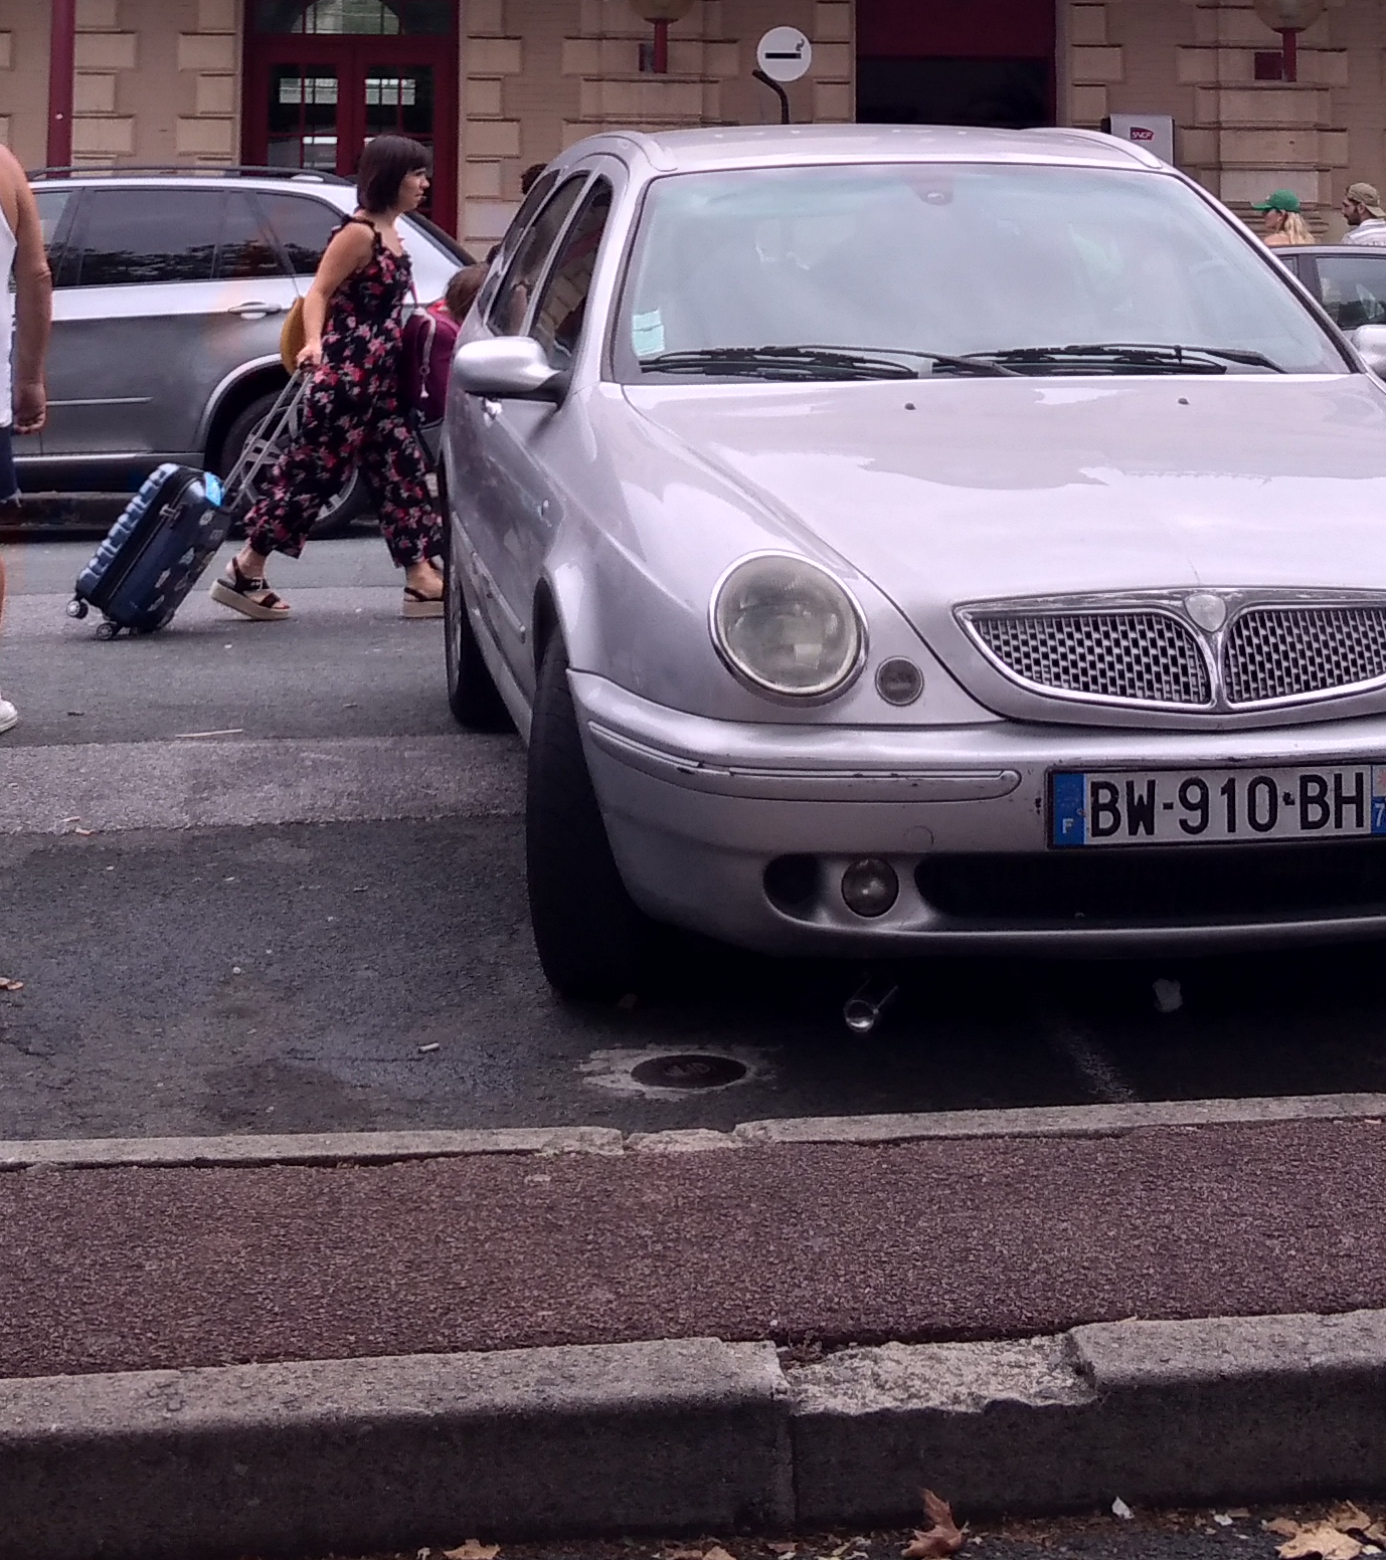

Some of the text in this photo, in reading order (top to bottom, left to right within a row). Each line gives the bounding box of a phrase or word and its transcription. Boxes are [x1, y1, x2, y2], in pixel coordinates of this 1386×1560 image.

[1132, 131, 1152, 139] SNCF
[1091, 772, 1365, 838] BW-910-BH
[1062, 818, 1075, 835] F
